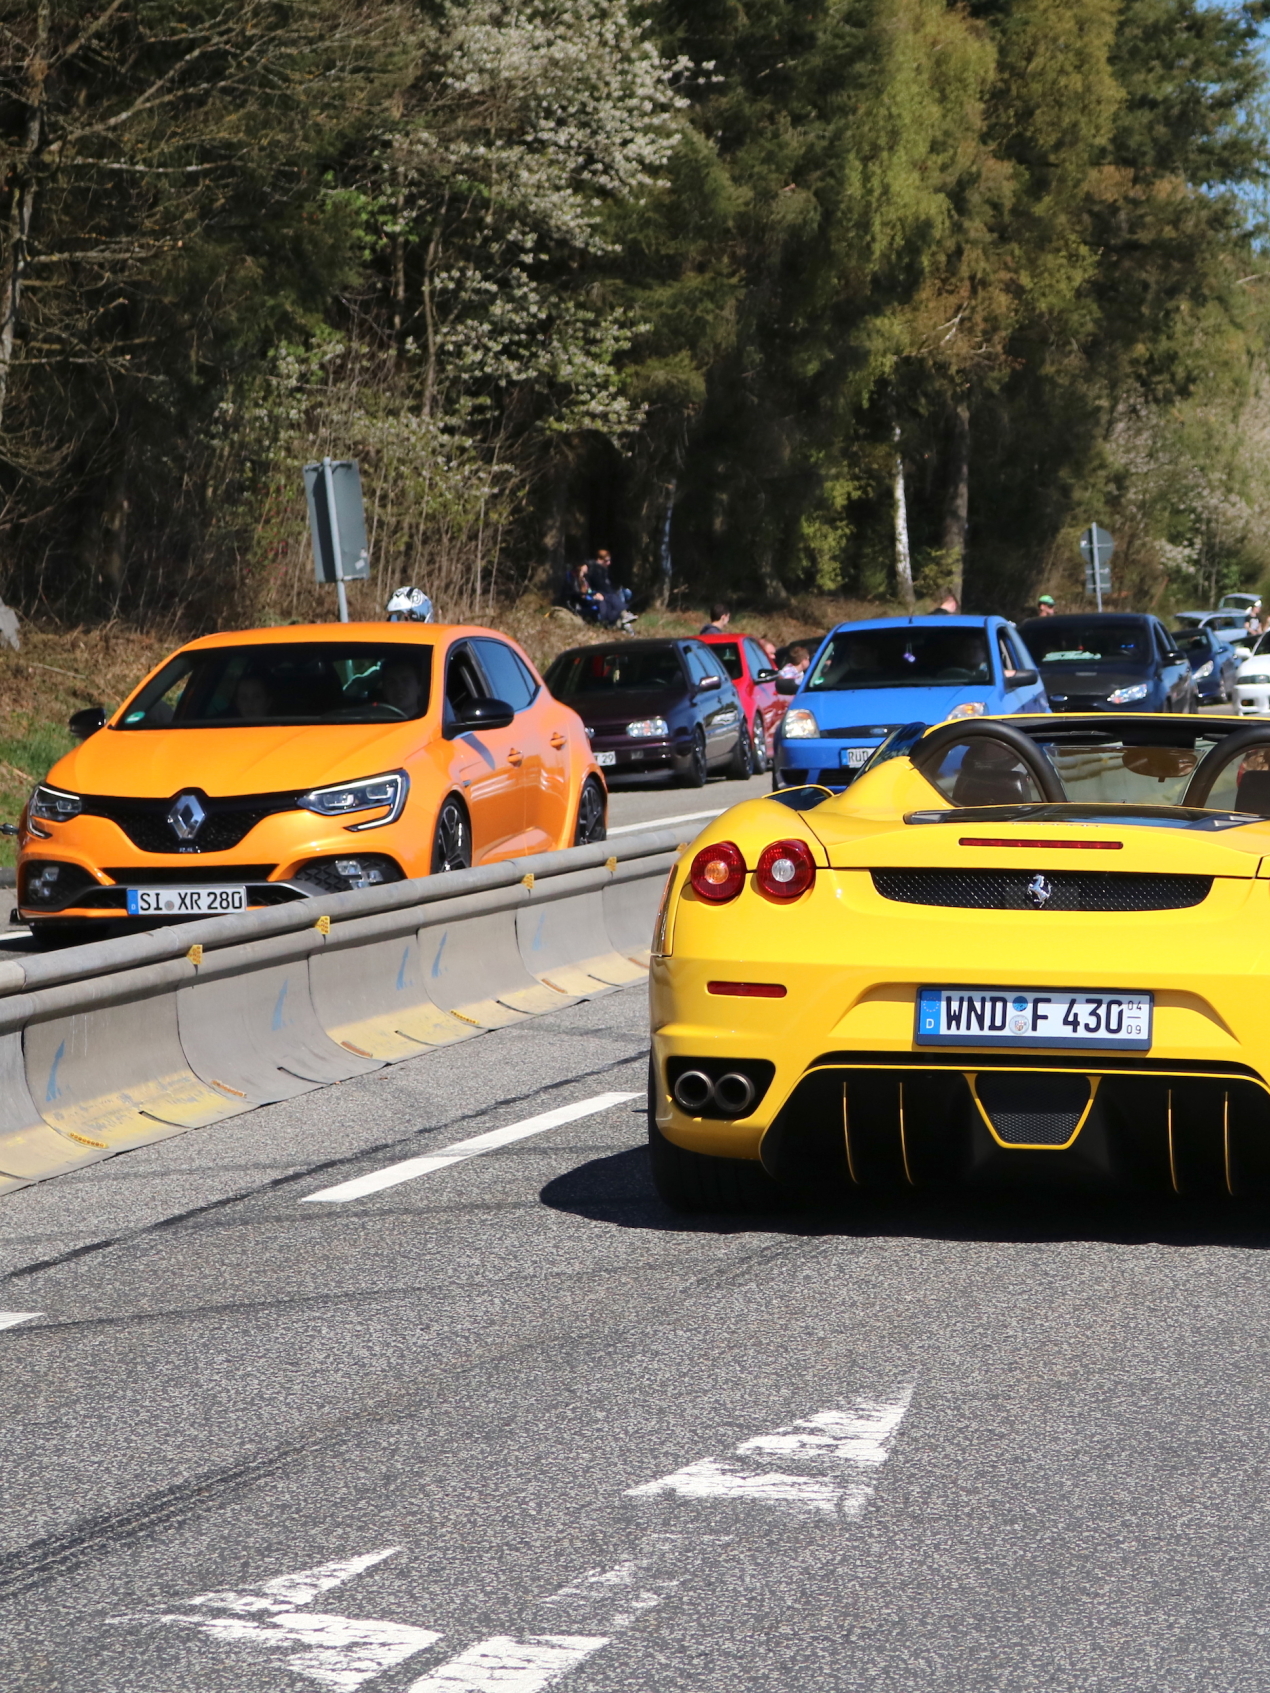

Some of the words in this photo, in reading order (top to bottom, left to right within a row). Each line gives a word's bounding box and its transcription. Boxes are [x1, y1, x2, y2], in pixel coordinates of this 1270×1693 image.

[140, 893, 162, 911] SI
[178, 892, 201, 910] XR
[207, 891, 243, 910] 280
[1128, 1000, 1142, 1011] 04
[926, 1018, 934, 1029] D
[946, 996, 1007, 1031] WND
[1031, 998, 1052, 1031] F
[1062, 998, 1124, 1034] 430
[1126, 1024, 1142, 1035] 09
